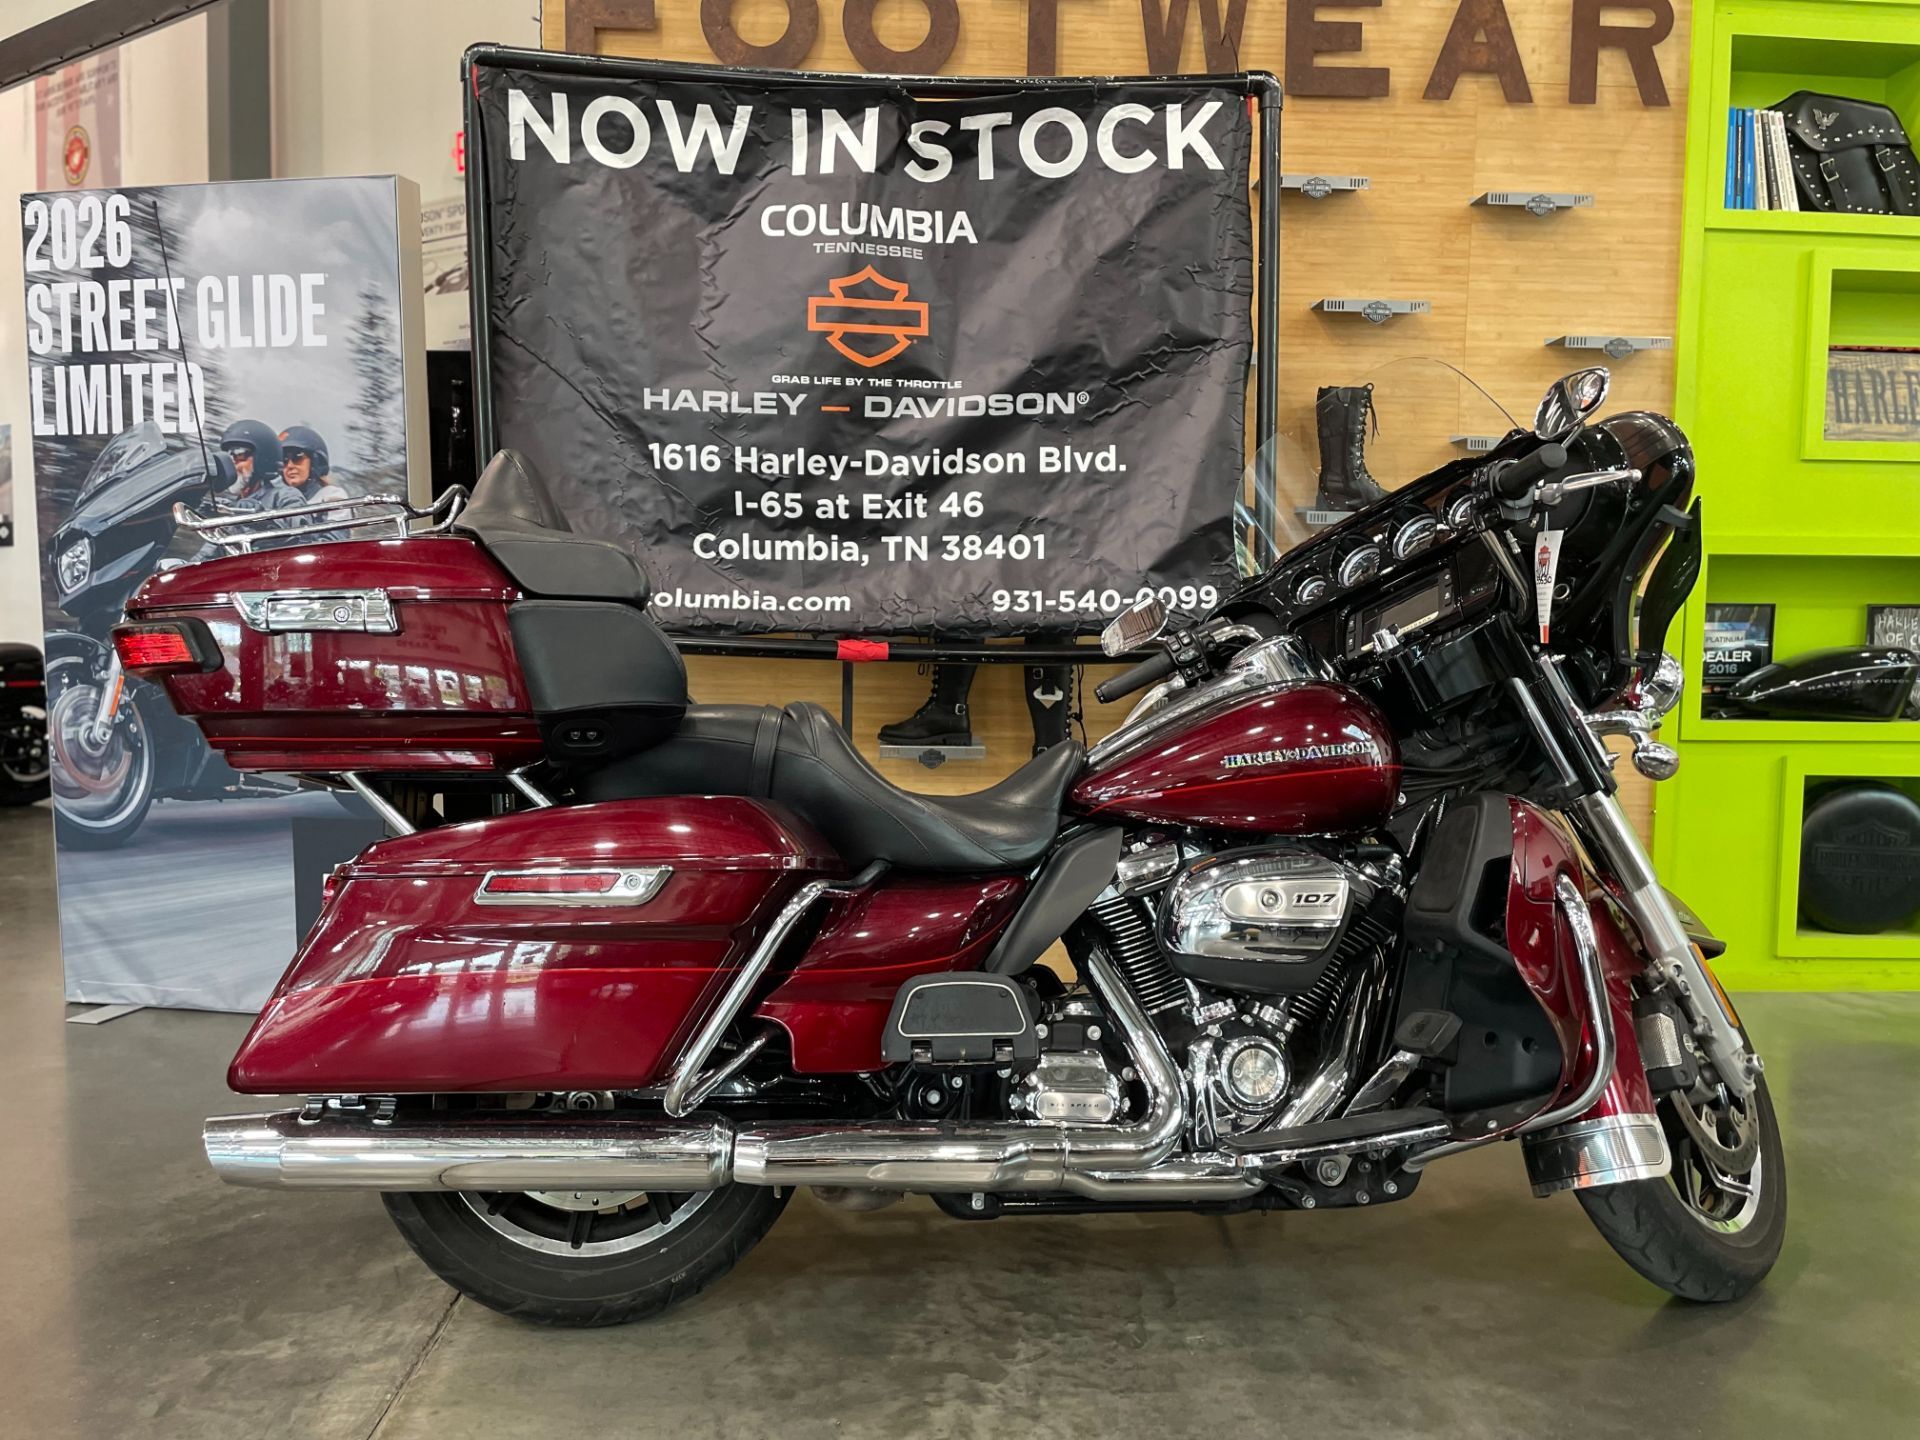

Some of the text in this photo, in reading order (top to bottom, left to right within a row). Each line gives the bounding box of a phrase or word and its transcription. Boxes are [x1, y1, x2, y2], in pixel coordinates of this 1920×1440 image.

[508, 89, 1224, 182] NOW IN STOCK
[25, 194, 132, 272] 2026
[761, 202, 979, 244] COLUMBIA
[813, 242, 923, 260] TENNESSEE
[27, 272, 328, 355] STREET GLIDE
[772, 374, 962, 390] GRAB LIFE BY THE THROTTLE
[32, 362, 205, 436] LIMITED
[643, 388, 807, 416] HARLEY
[648, 442, 1127, 481] 1616 Harley-Davidson Blvd.
[735, 490, 984, 520] I-65 at Exit 46
[693, 532, 1046, 566] Columbia, TN 38401
[647, 587, 851, 612] olumbia.com
[1708, 663, 1738, 674] 2016
[1295, 893, 1337, 904] 107
